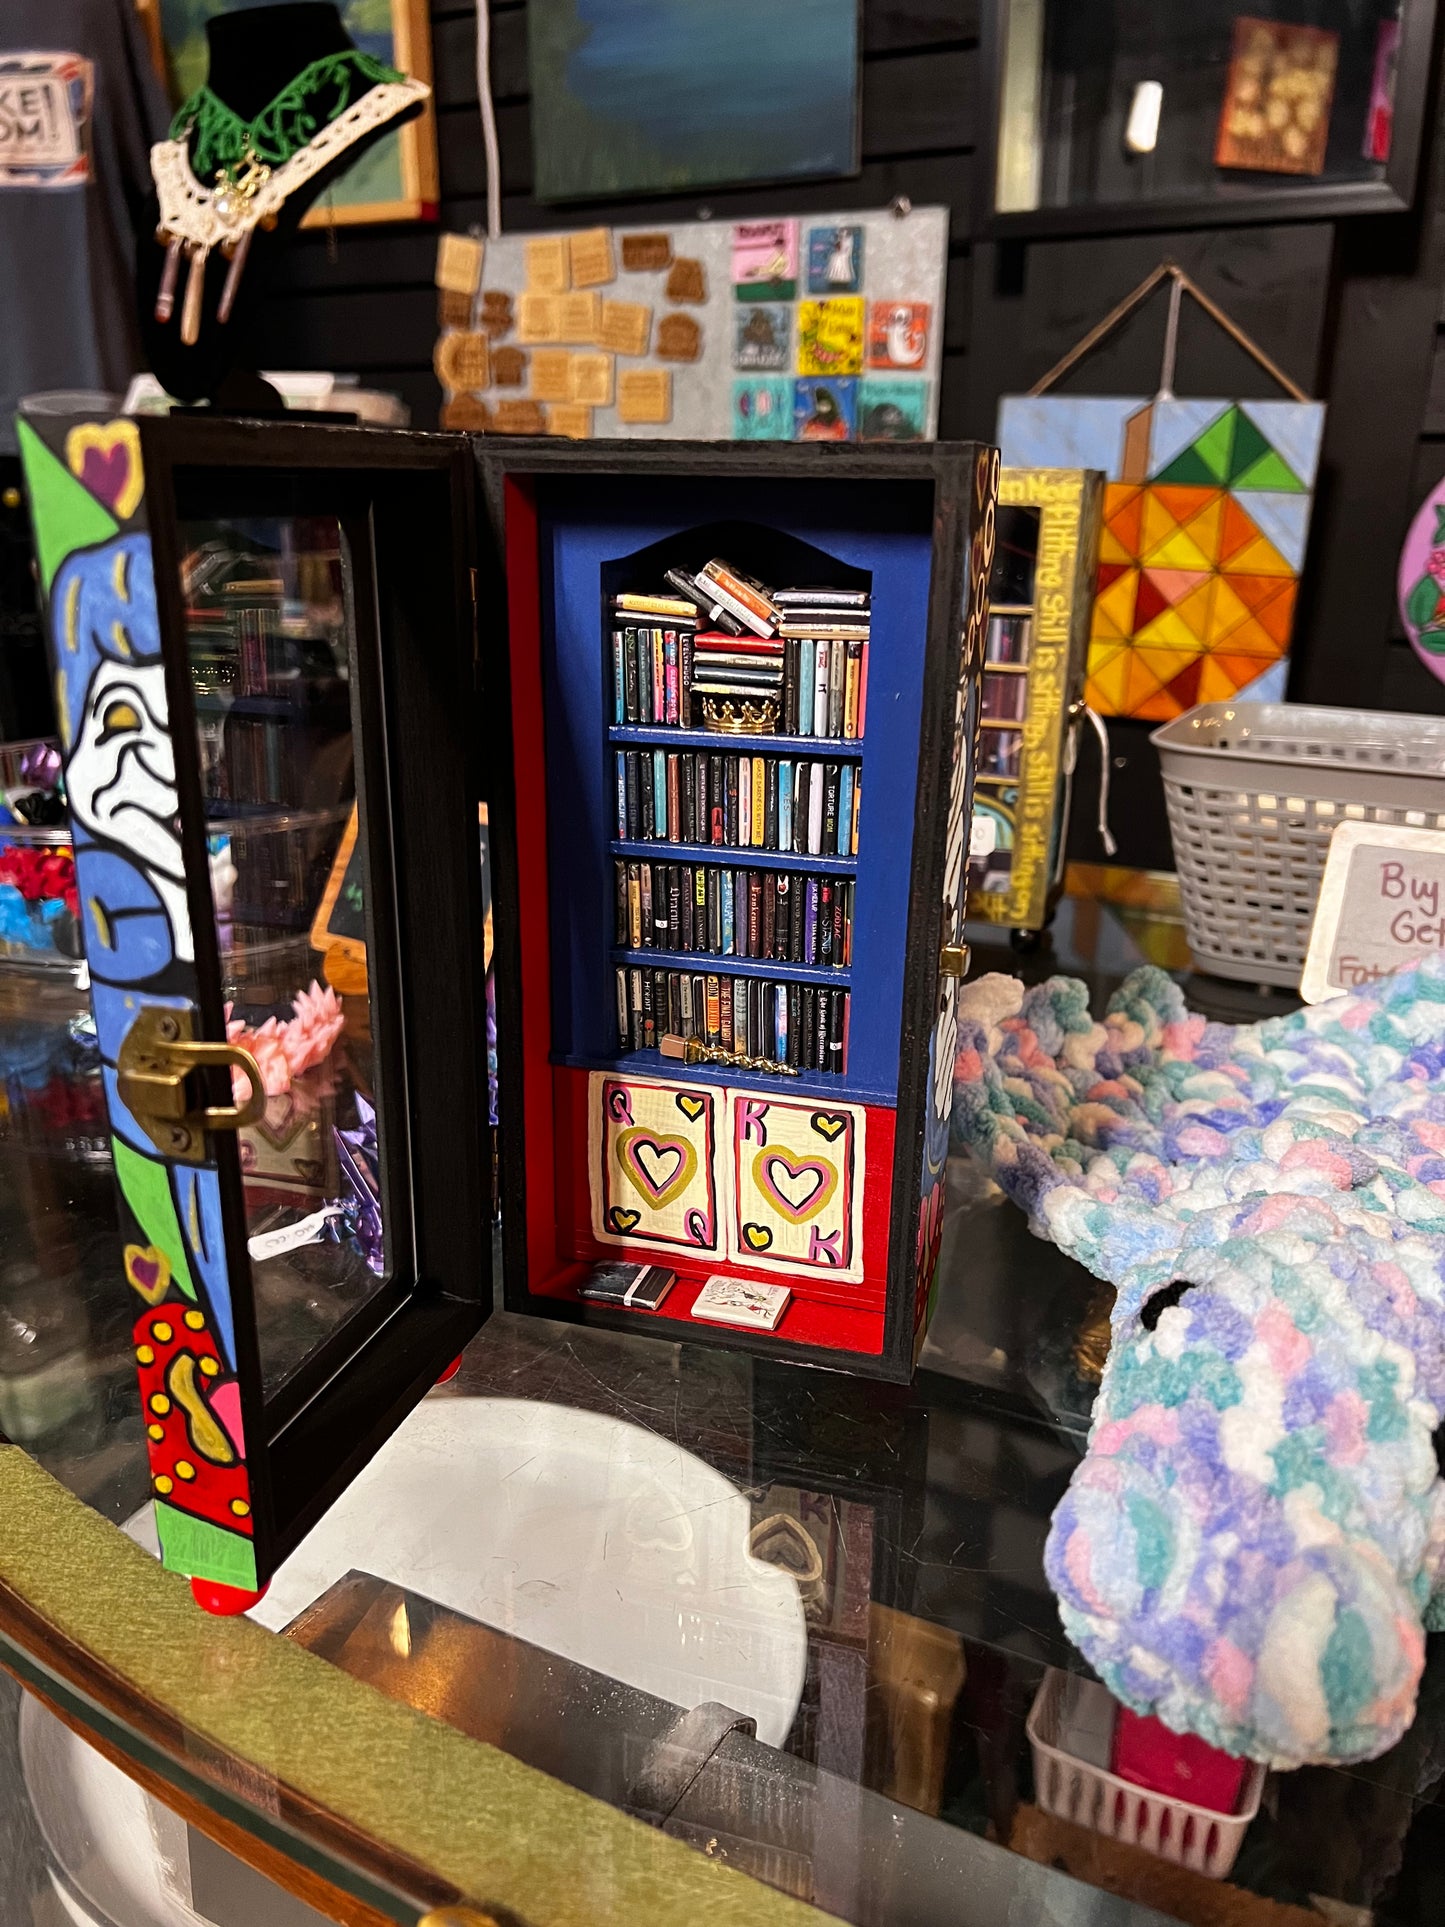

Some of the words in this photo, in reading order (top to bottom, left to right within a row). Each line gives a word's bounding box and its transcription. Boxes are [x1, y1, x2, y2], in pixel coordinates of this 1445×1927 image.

[827, 785, 835, 817] TORTURE
[670, 887, 680, 930] Dracula
[1380, 862, 1439, 917] Buy
[751, 886, 761, 941] Frankenstein
[1390, 910, 1445, 949] Get
[821, 919, 832, 955] STAND
[708, 982, 718, 997] DON
[721, 988, 730, 999] THE
[721, 1000, 731, 1017] FINAL
[708, 998, 718, 1029] QUIXOTE
[721, 1020, 731, 1042] GAMBIT
[609, 1086, 635, 1127] Q
[740, 1100, 771, 1147] K
[684, 1207, 712, 1247] Q
[809, 1225, 842, 1265] K
